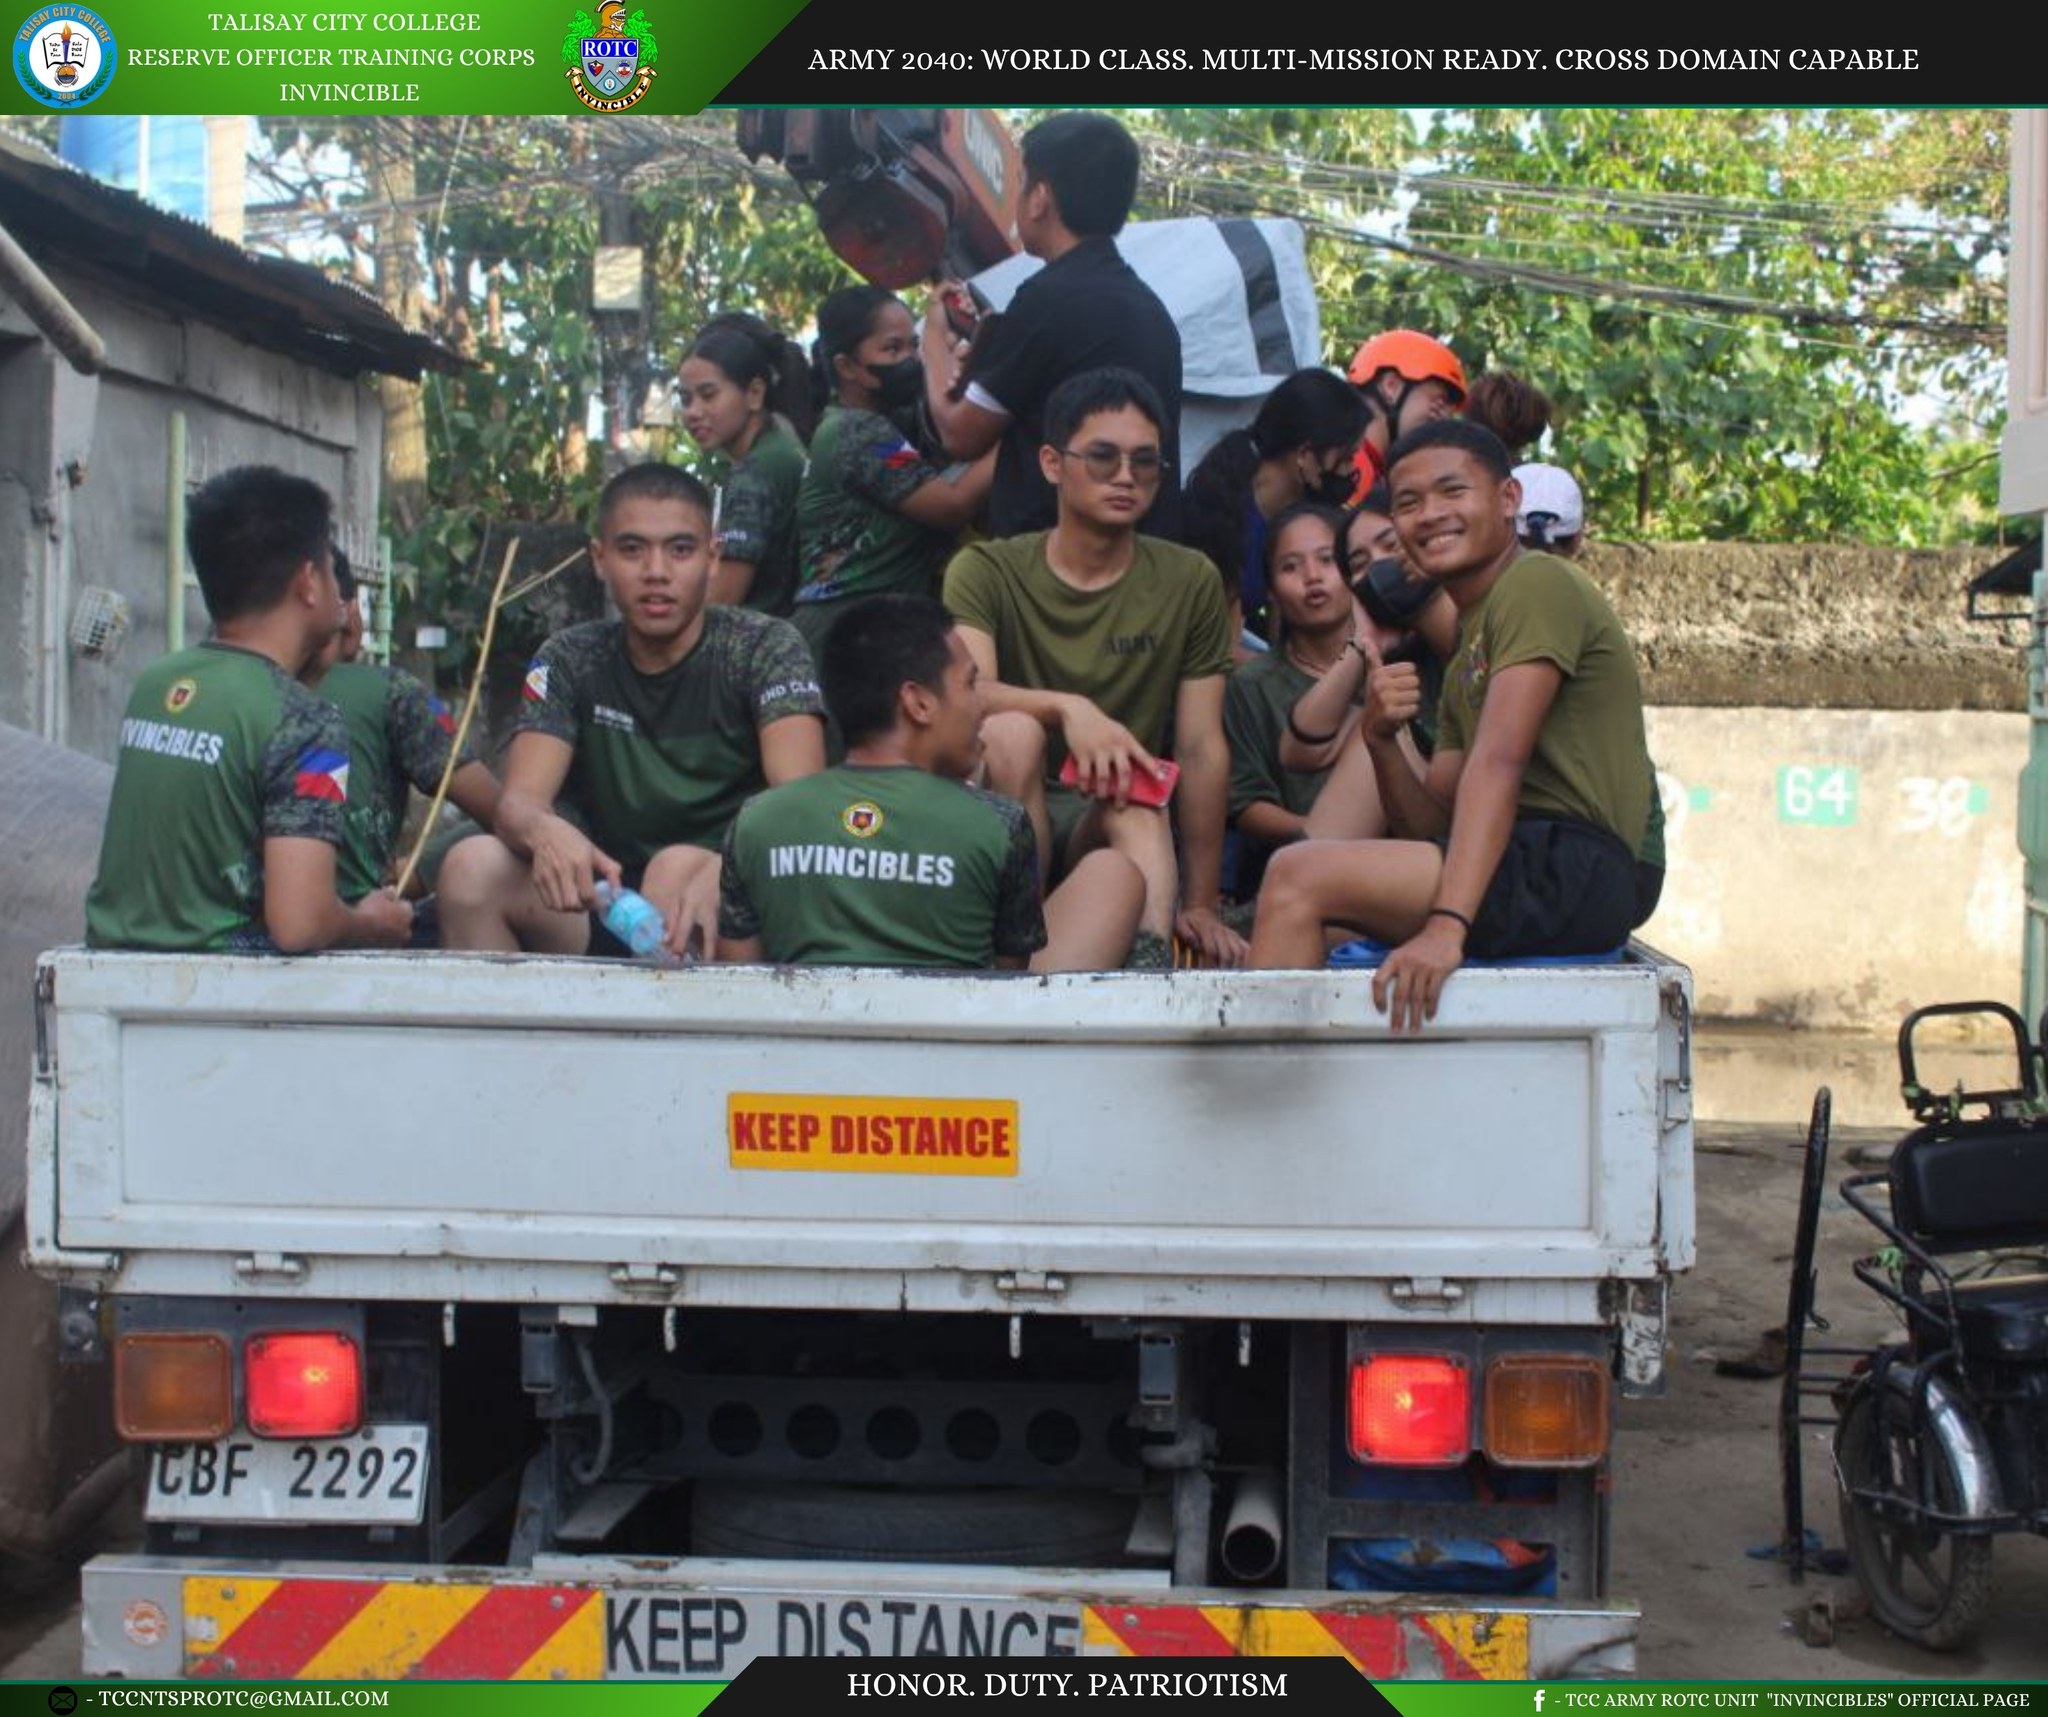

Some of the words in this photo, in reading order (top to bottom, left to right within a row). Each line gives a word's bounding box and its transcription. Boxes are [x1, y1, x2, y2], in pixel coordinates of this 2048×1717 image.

[1783, 765, 1854, 817] 64
[769, 844, 955, 887] INVINCIBLES
[733, 1111, 820, 1152] KEEP
[830, 1114, 1010, 1158] DISTANCE
[154, 1443, 253, 1497] CBF
[289, 1445, 417, 1499] 2292
[606, 1598, 747, 1675] KEEP
[777, 1600, 1080, 1657] DISTANCE
